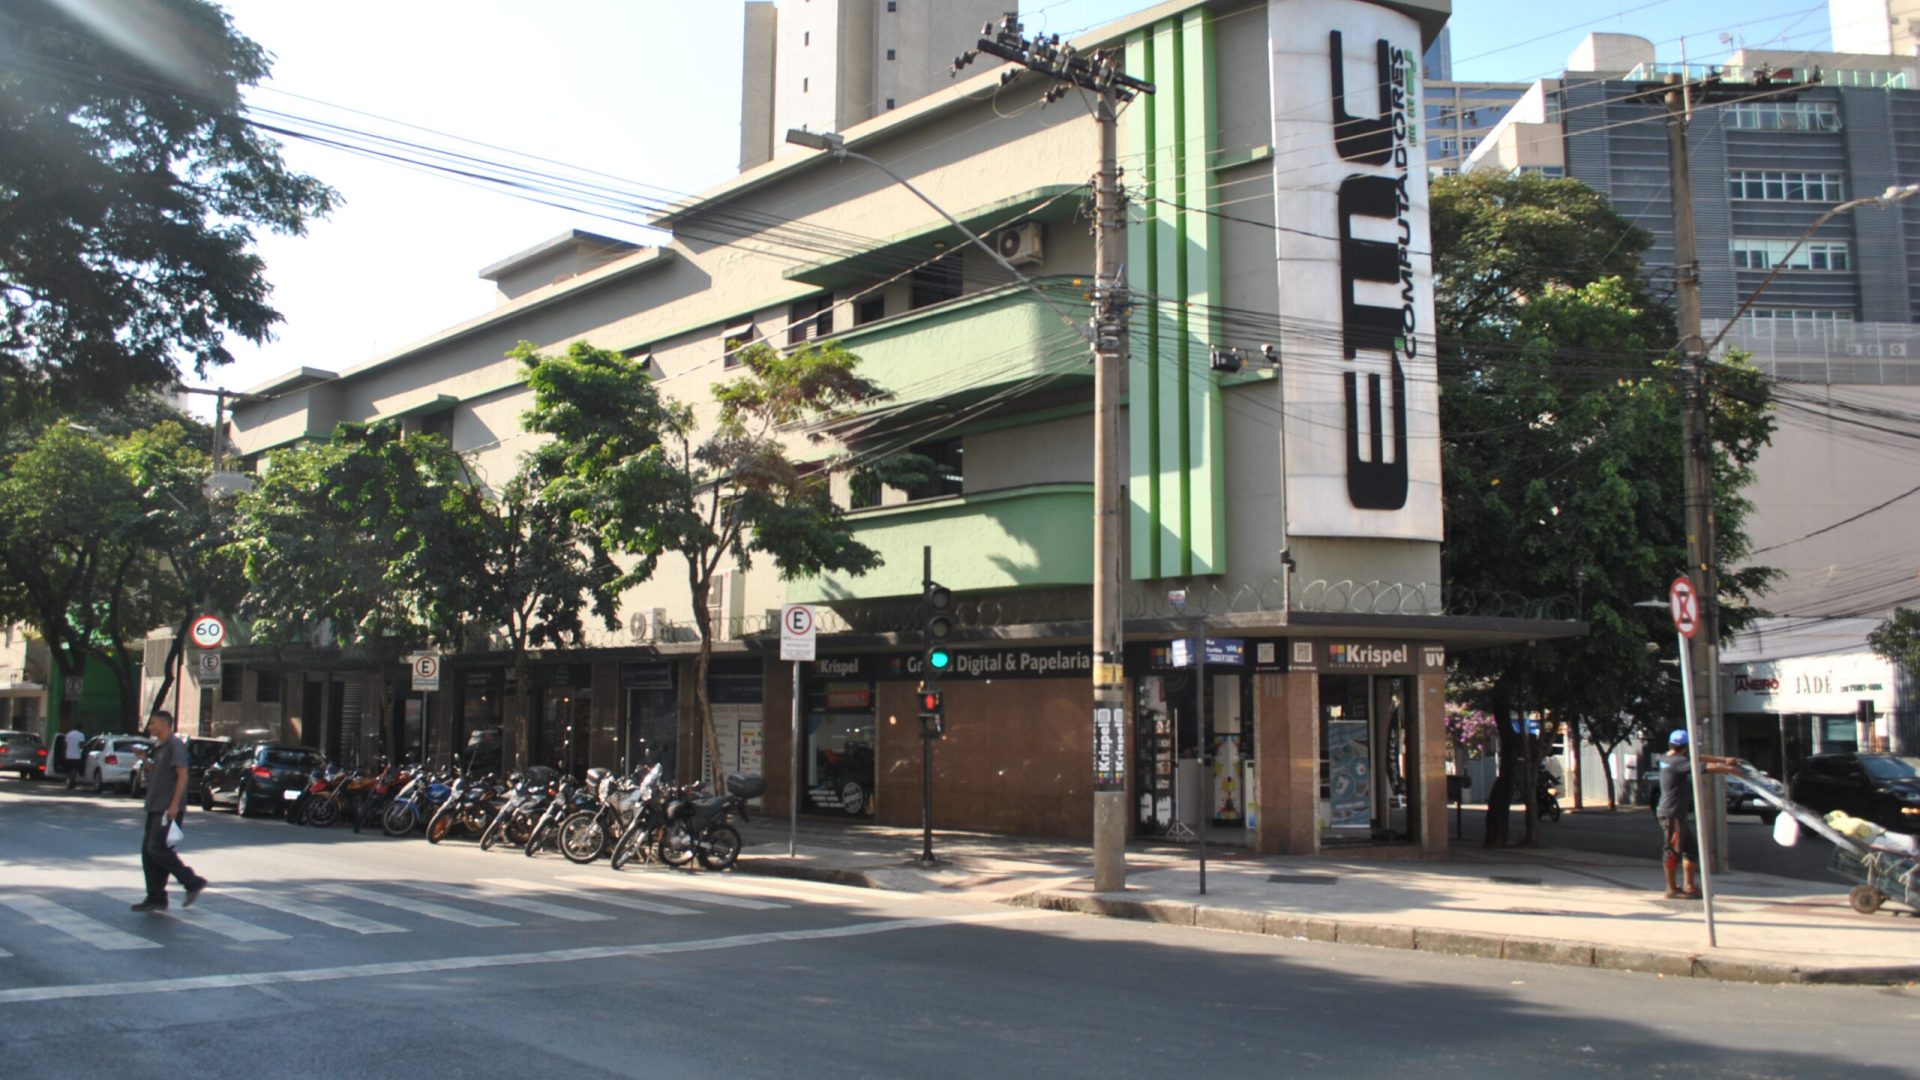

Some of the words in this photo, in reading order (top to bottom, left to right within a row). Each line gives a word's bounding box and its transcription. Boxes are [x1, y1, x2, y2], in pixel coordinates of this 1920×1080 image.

[1390, 45, 1417, 360] COMPUTADORES
[196, 622, 220, 636] 60
[793, 611, 804, 629] E
[957, 654, 1002, 676] Digital
[1005, 652, 1016, 671] &
[1020, 651, 1091, 675] Papelaria
[1346, 643, 1408, 668] Krispel
[1425, 653, 1445, 667] UV
[820, 657, 859, 677] Krispel
[1098, 722, 1113, 771] Krispel
